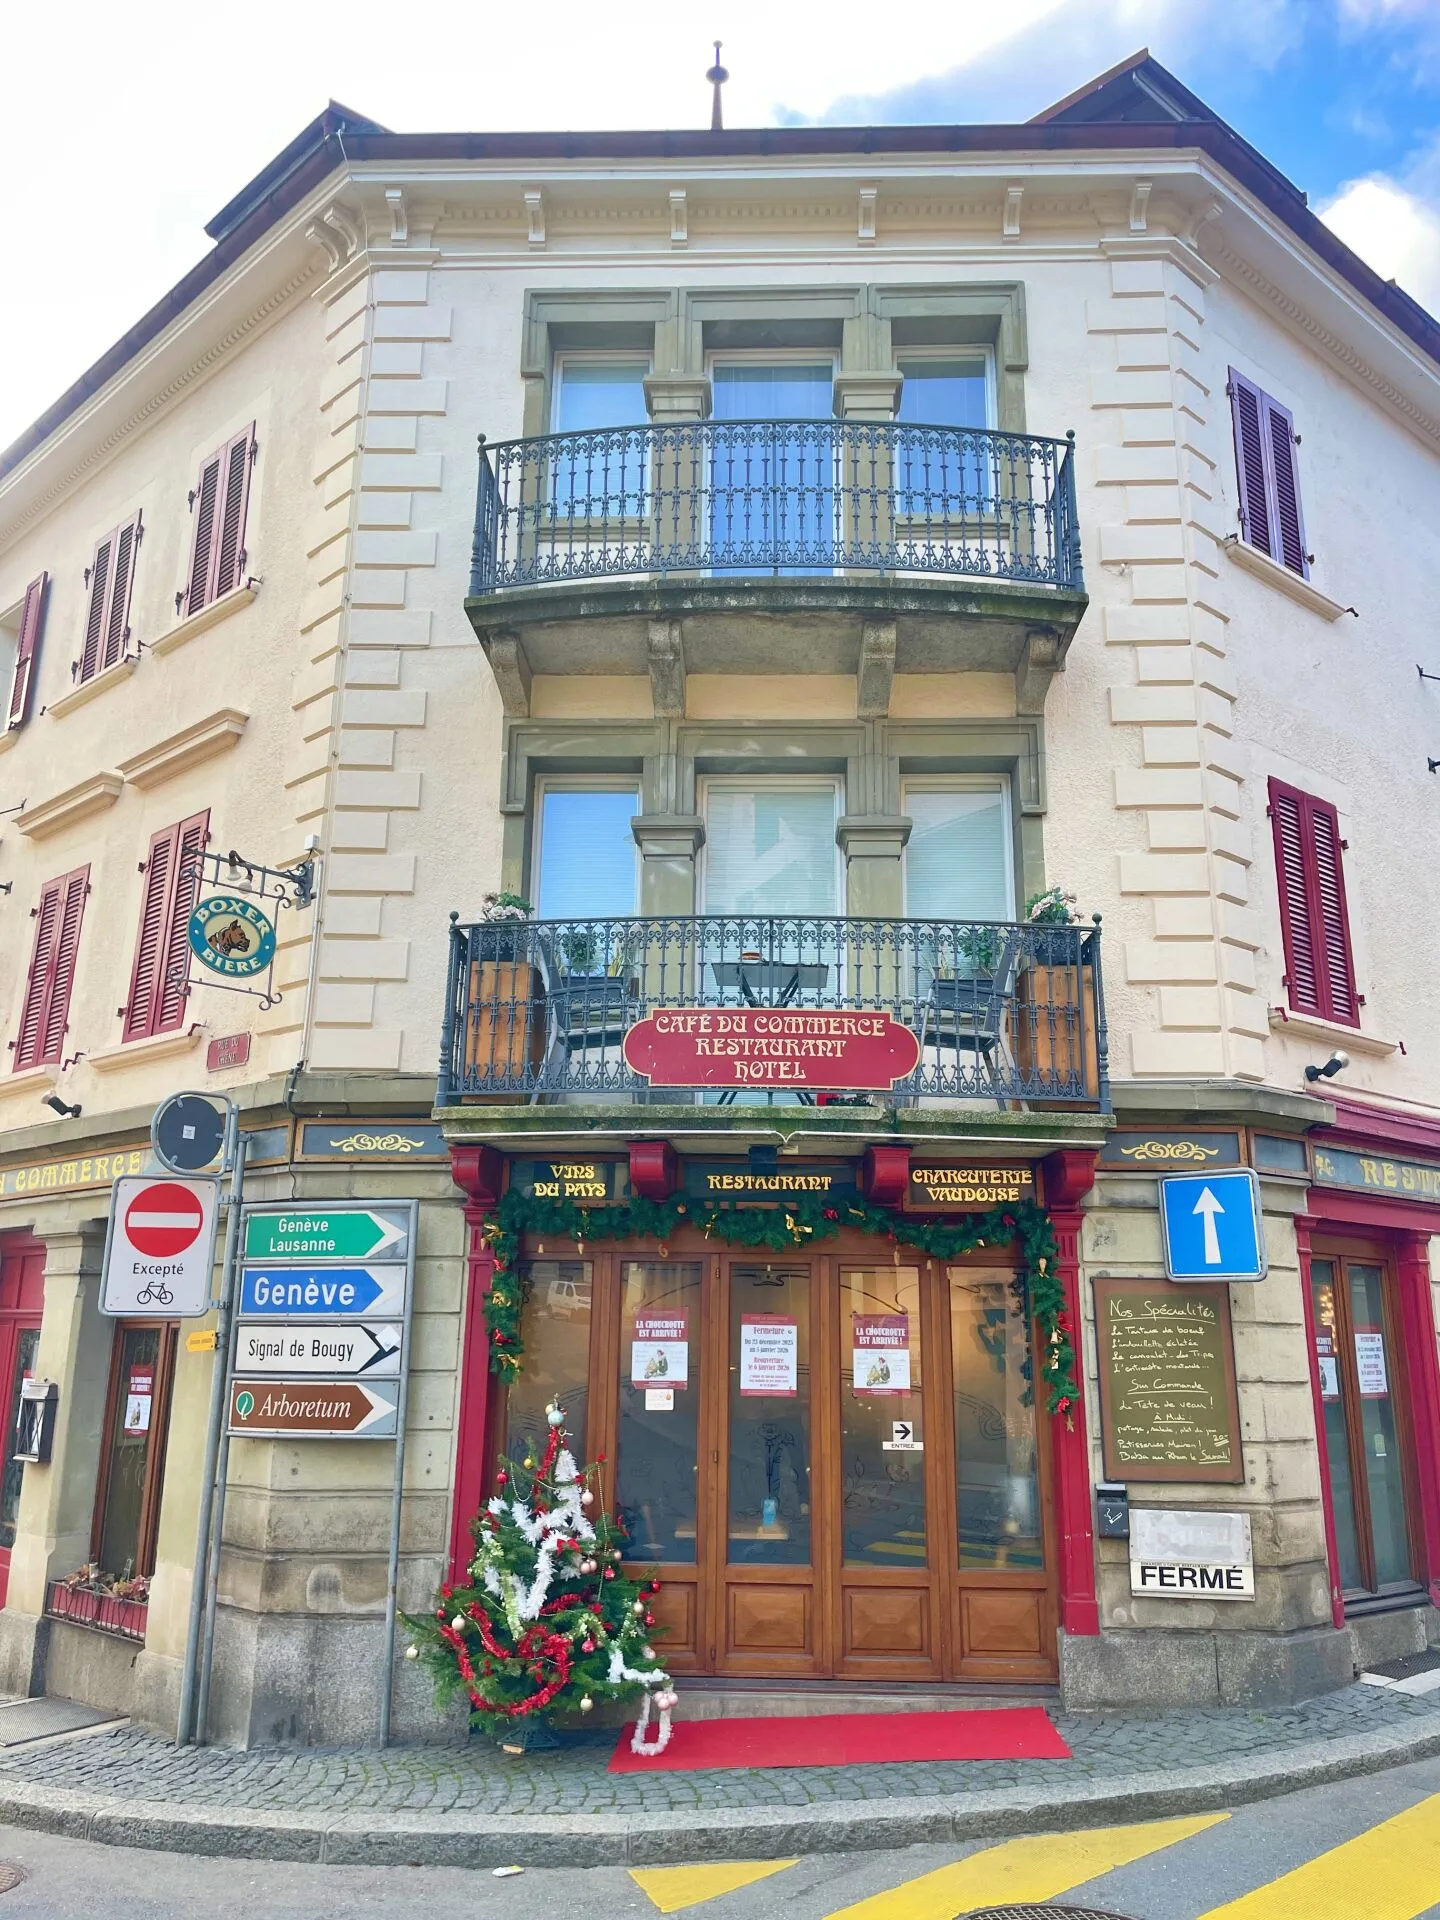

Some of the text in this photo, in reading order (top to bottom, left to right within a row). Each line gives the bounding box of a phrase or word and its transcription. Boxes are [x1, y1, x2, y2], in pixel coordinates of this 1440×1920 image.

[195, 900, 270, 939] BOXER
[202, 947, 261, 973] BIERE
[655, 1013, 886, 1037] CAFÉ DU COMMERCE
[217, 1039, 229, 1050] RUE
[695, 1038, 847, 1058] RESTAURANT
[733, 1060, 807, 1082] HOTEL
[15, 1151, 141, 1192] COMMERCE
[550, 1164, 595, 1179] VINS
[912, 1169, 1033, 1184] CHARCUTERIE
[533, 1182, 607, 1197] DU PAYS
[707, 1175, 832, 1191] RESTAURANT
[926, 1187, 1020, 1202] VAUDOISE
[278, 1218, 329, 1233] Genève
[269, 1237, 336, 1252] Lausanne
[132, 1262, 184, 1276] Excepté
[254, 1276, 355, 1305] Genève
[1110, 1299, 1215, 1321] Nos Spécialités
[636, 1320, 685, 1328] LA CHOUCROUTE
[753, 1327, 785, 1335] Fermeture
[856, 1327, 906, 1336] LA CHOUCROUTE
[1125, 1326, 1159, 1335] Tartare
[639, 1329, 650, 1337] EST
[651, 1328, 678, 1337] ARRIVÉE
[859, 1336, 871, 1344] EST
[871, 1336, 899, 1345] ARRIVÉE
[248, 1339, 354, 1362] Signal de Bougy
[1128, 1378, 1204, 1392] Sur Commande
[258, 1392, 351, 1418] Arboretum
[1119, 1451, 1149, 1461] Baba
[1140, 1565, 1244, 1590] FERMÉ
